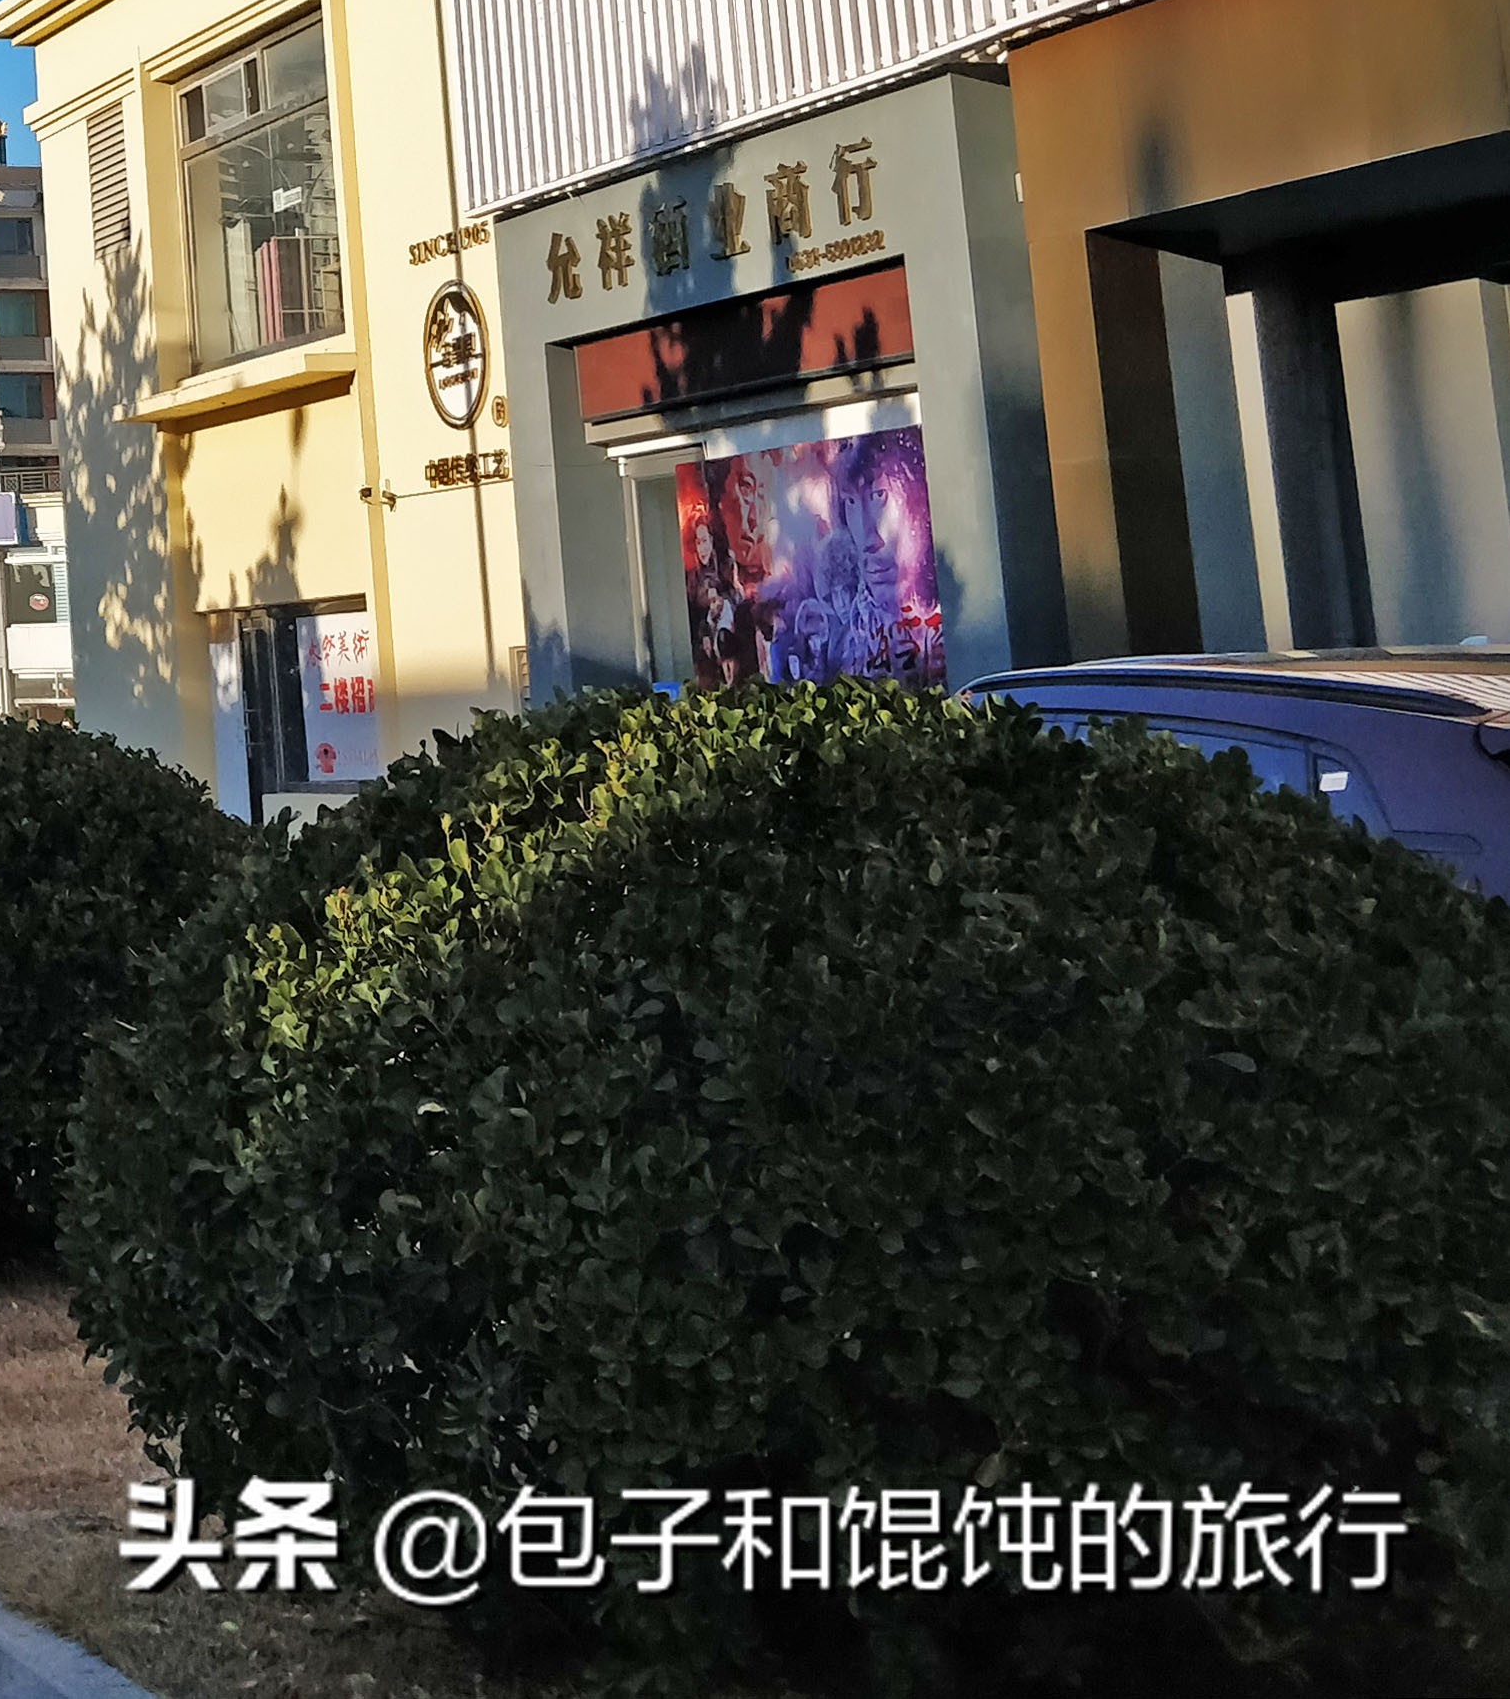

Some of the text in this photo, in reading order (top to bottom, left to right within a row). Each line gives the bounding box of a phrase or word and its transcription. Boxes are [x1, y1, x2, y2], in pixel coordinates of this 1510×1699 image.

[409, 220, 491, 266] SINCE 1905
[547, 137, 878, 304] 允祥酒业商行
